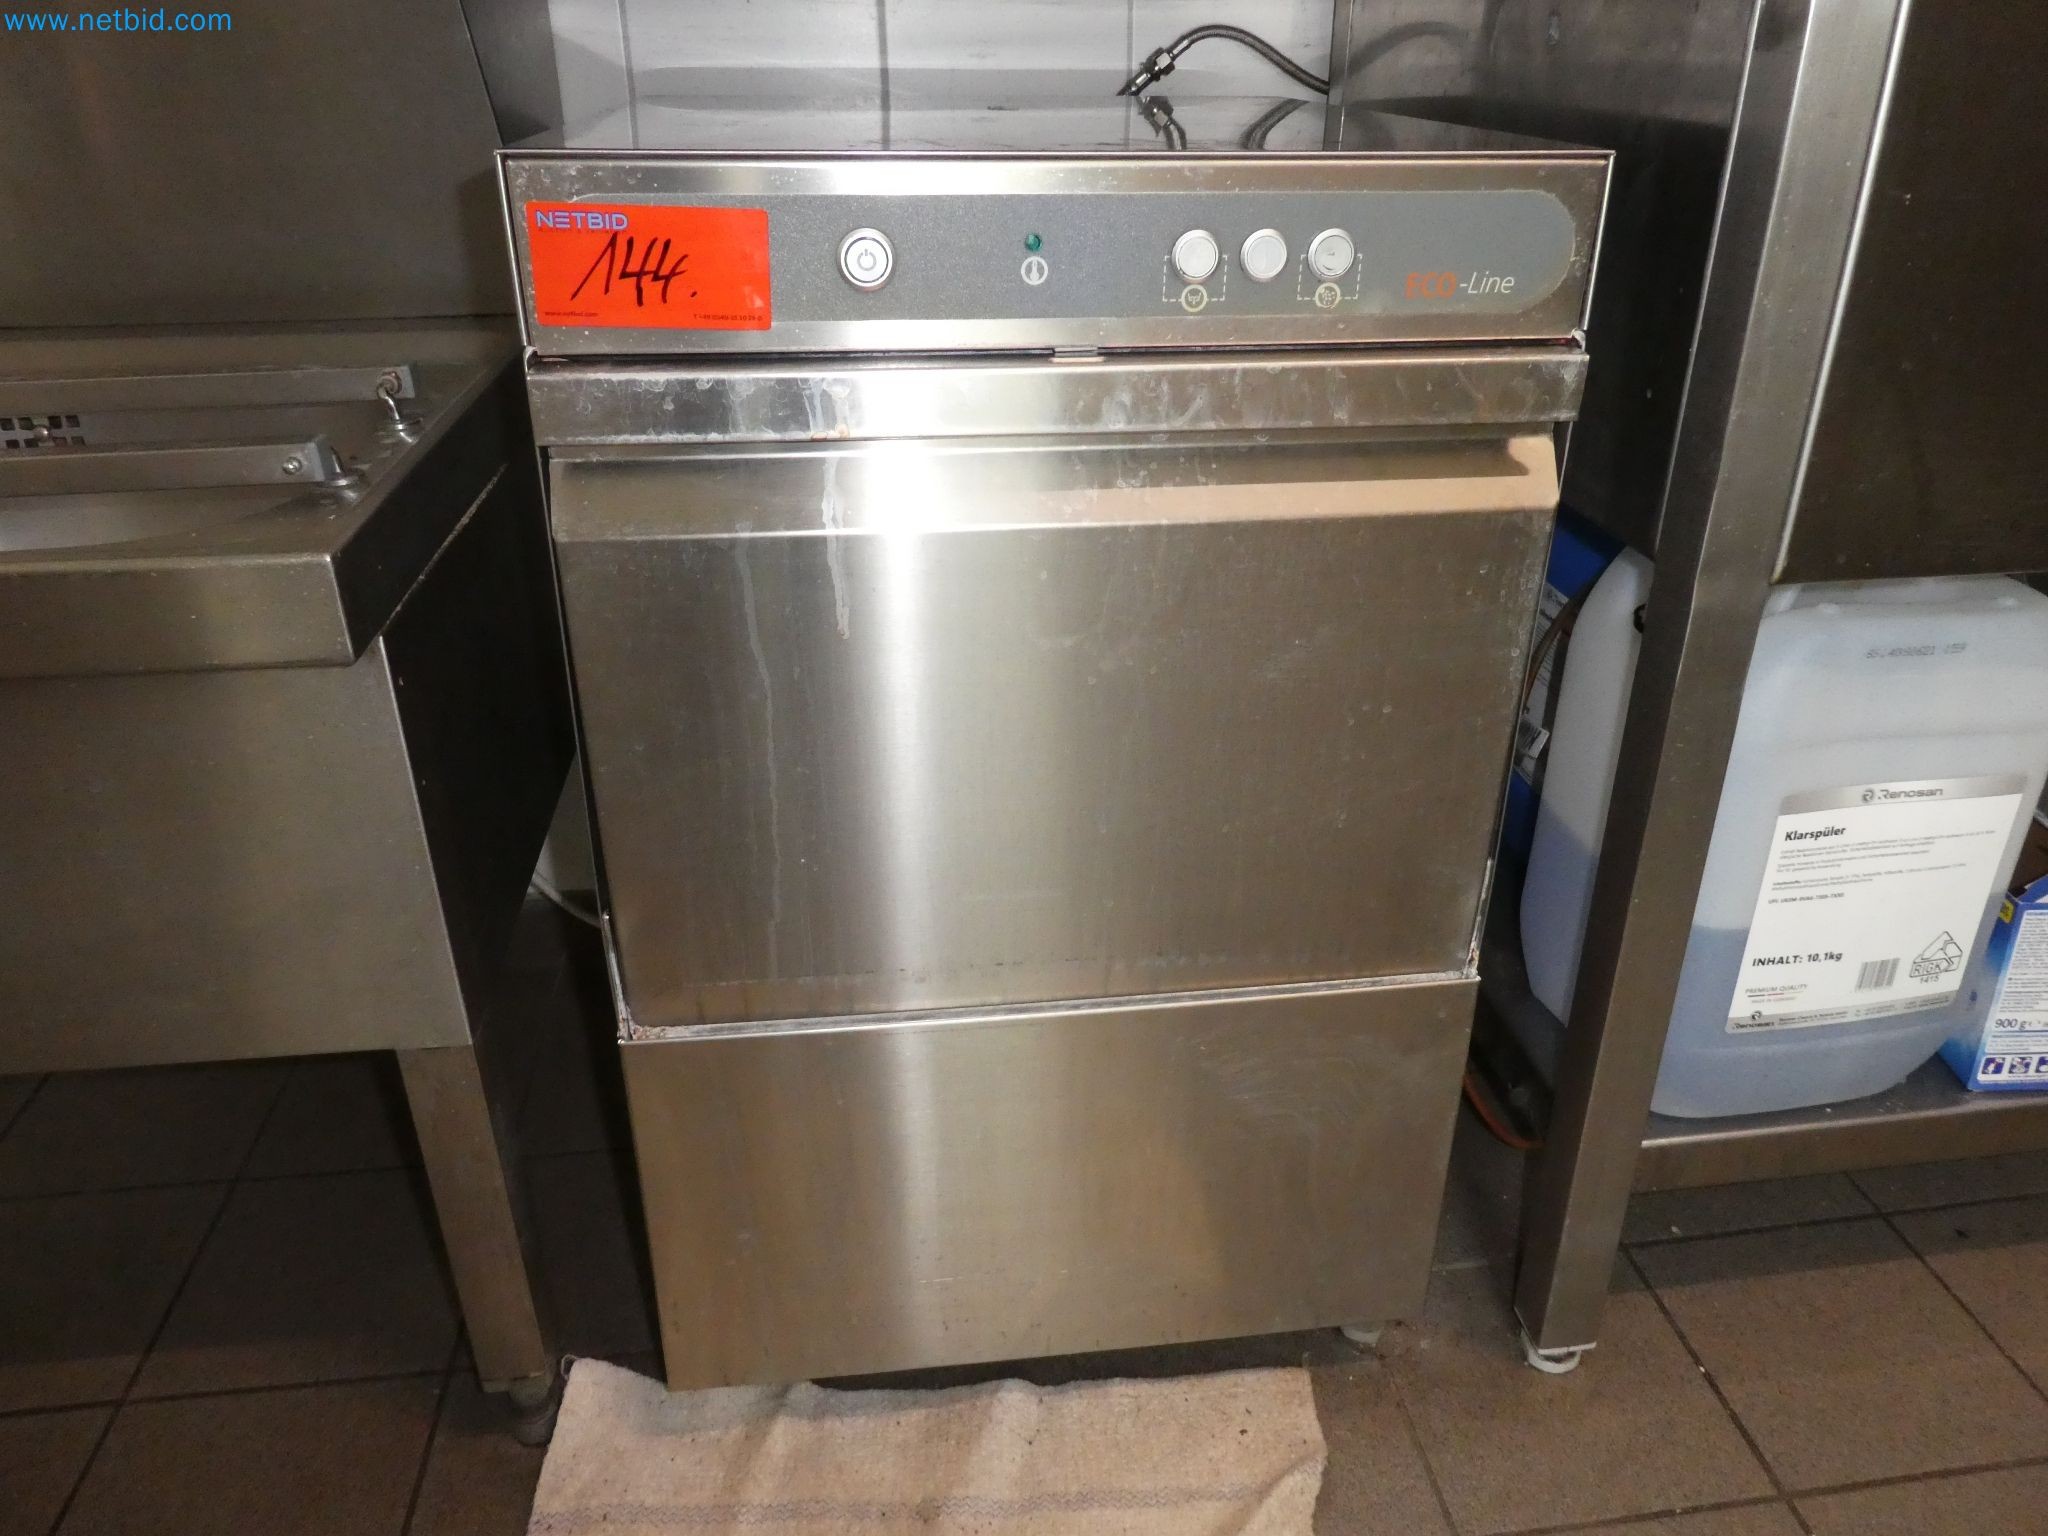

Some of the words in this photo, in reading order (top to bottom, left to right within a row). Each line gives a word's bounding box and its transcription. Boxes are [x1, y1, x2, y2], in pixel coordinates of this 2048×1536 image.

[535, 210, 629, 230] NETBID
[1784, 825, 1846, 842] Klarspüler
[1752, 954, 1804, 967] INHALT:
[1994, 1018, 2018, 1029] 900
